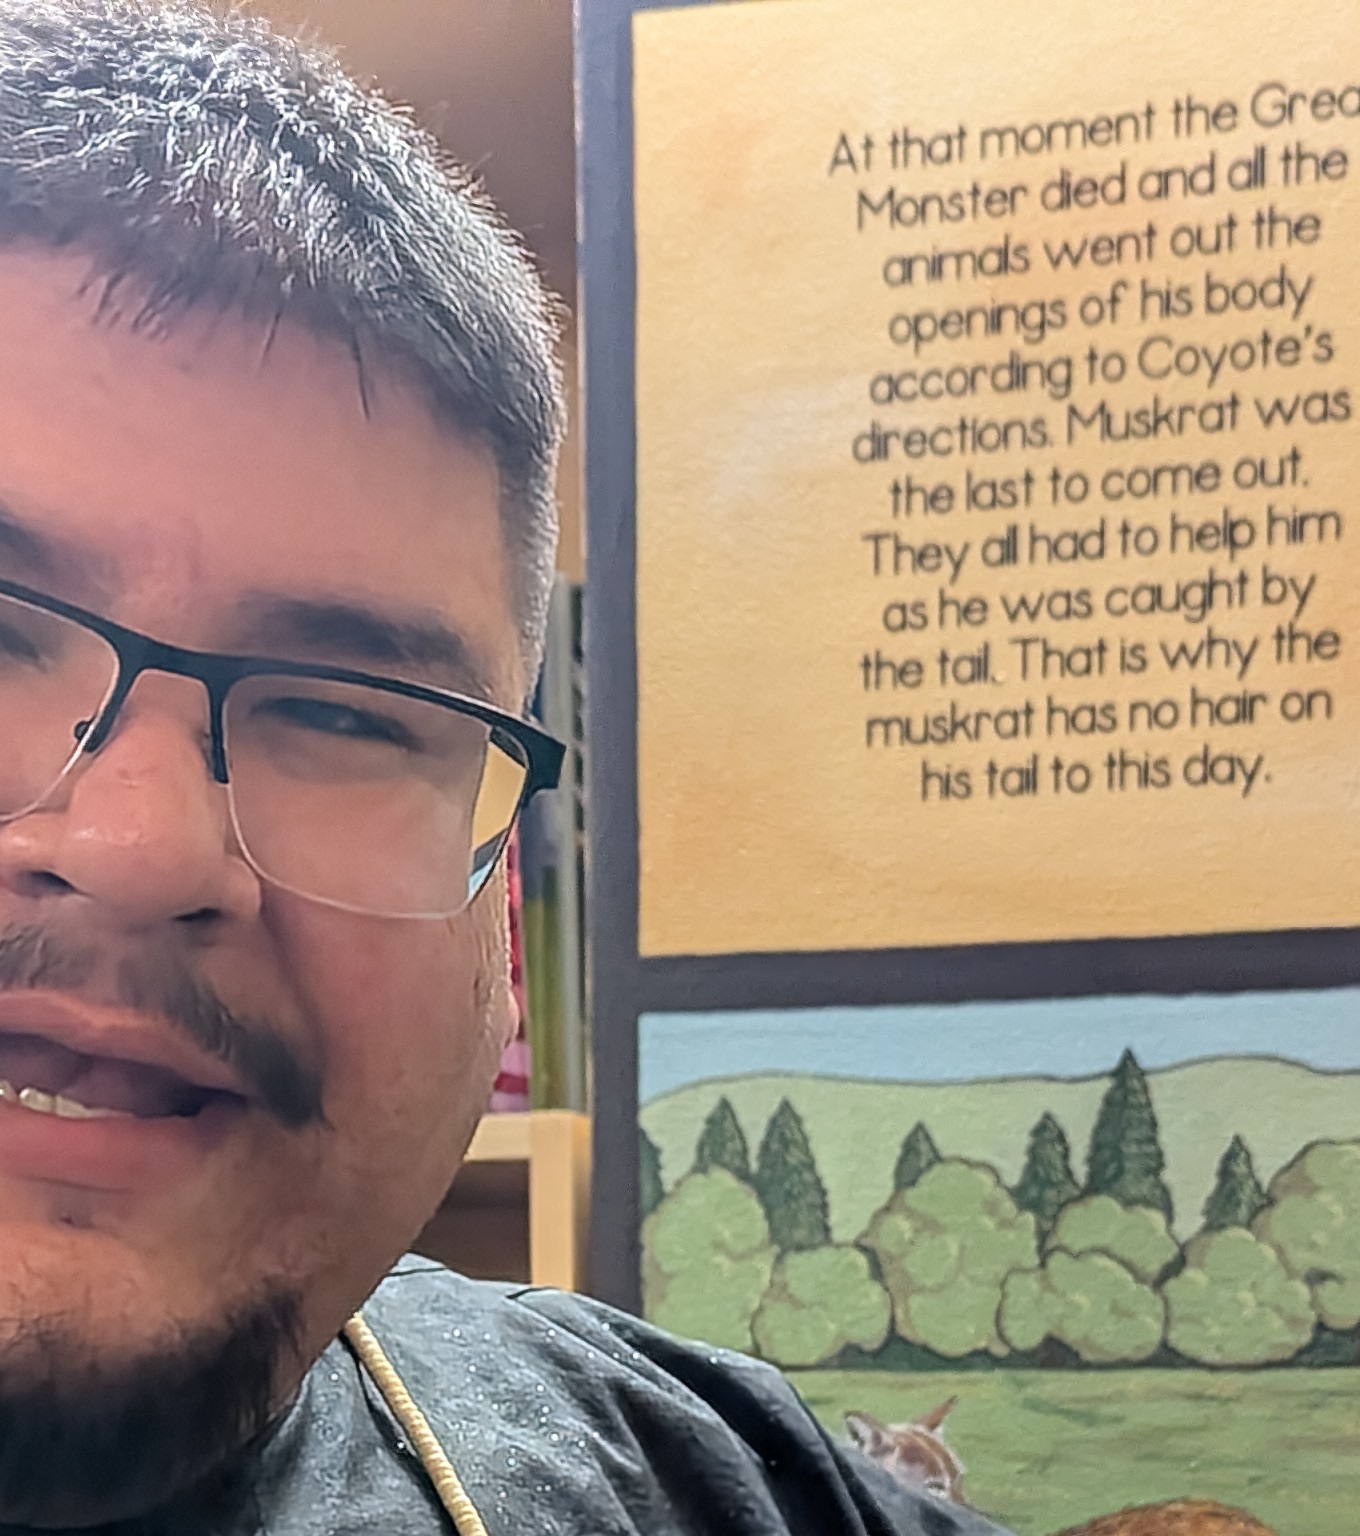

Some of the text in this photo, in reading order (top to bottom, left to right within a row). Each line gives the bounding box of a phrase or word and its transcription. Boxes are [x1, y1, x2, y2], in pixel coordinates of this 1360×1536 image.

[830, 133, 874, 173] At
[889, 125, 967, 168] that
[980, 103, 1155, 158] moment
[1173, 95, 1238, 136] the
[858, 141, 1348, 230] Monster died and all the
[883, 205, 1321, 286] animals went out the
[889, 264, 1313, 354] openings of his body
[870, 325, 1334, 404] according to Coyote's
[853, 390, 1351, 463] directions. Muskrat was
[890, 446, 1308, 517] the last to come out.
[863, 505, 1342, 585] They all had to help him
[883, 565, 1316, 633] as he was caught by
[861, 621, 1341, 690] the tail. That is why the
[866, 687, 1332, 747] muskrat has no hair on
[922, 744, 1270, 801] his tail to this day.
